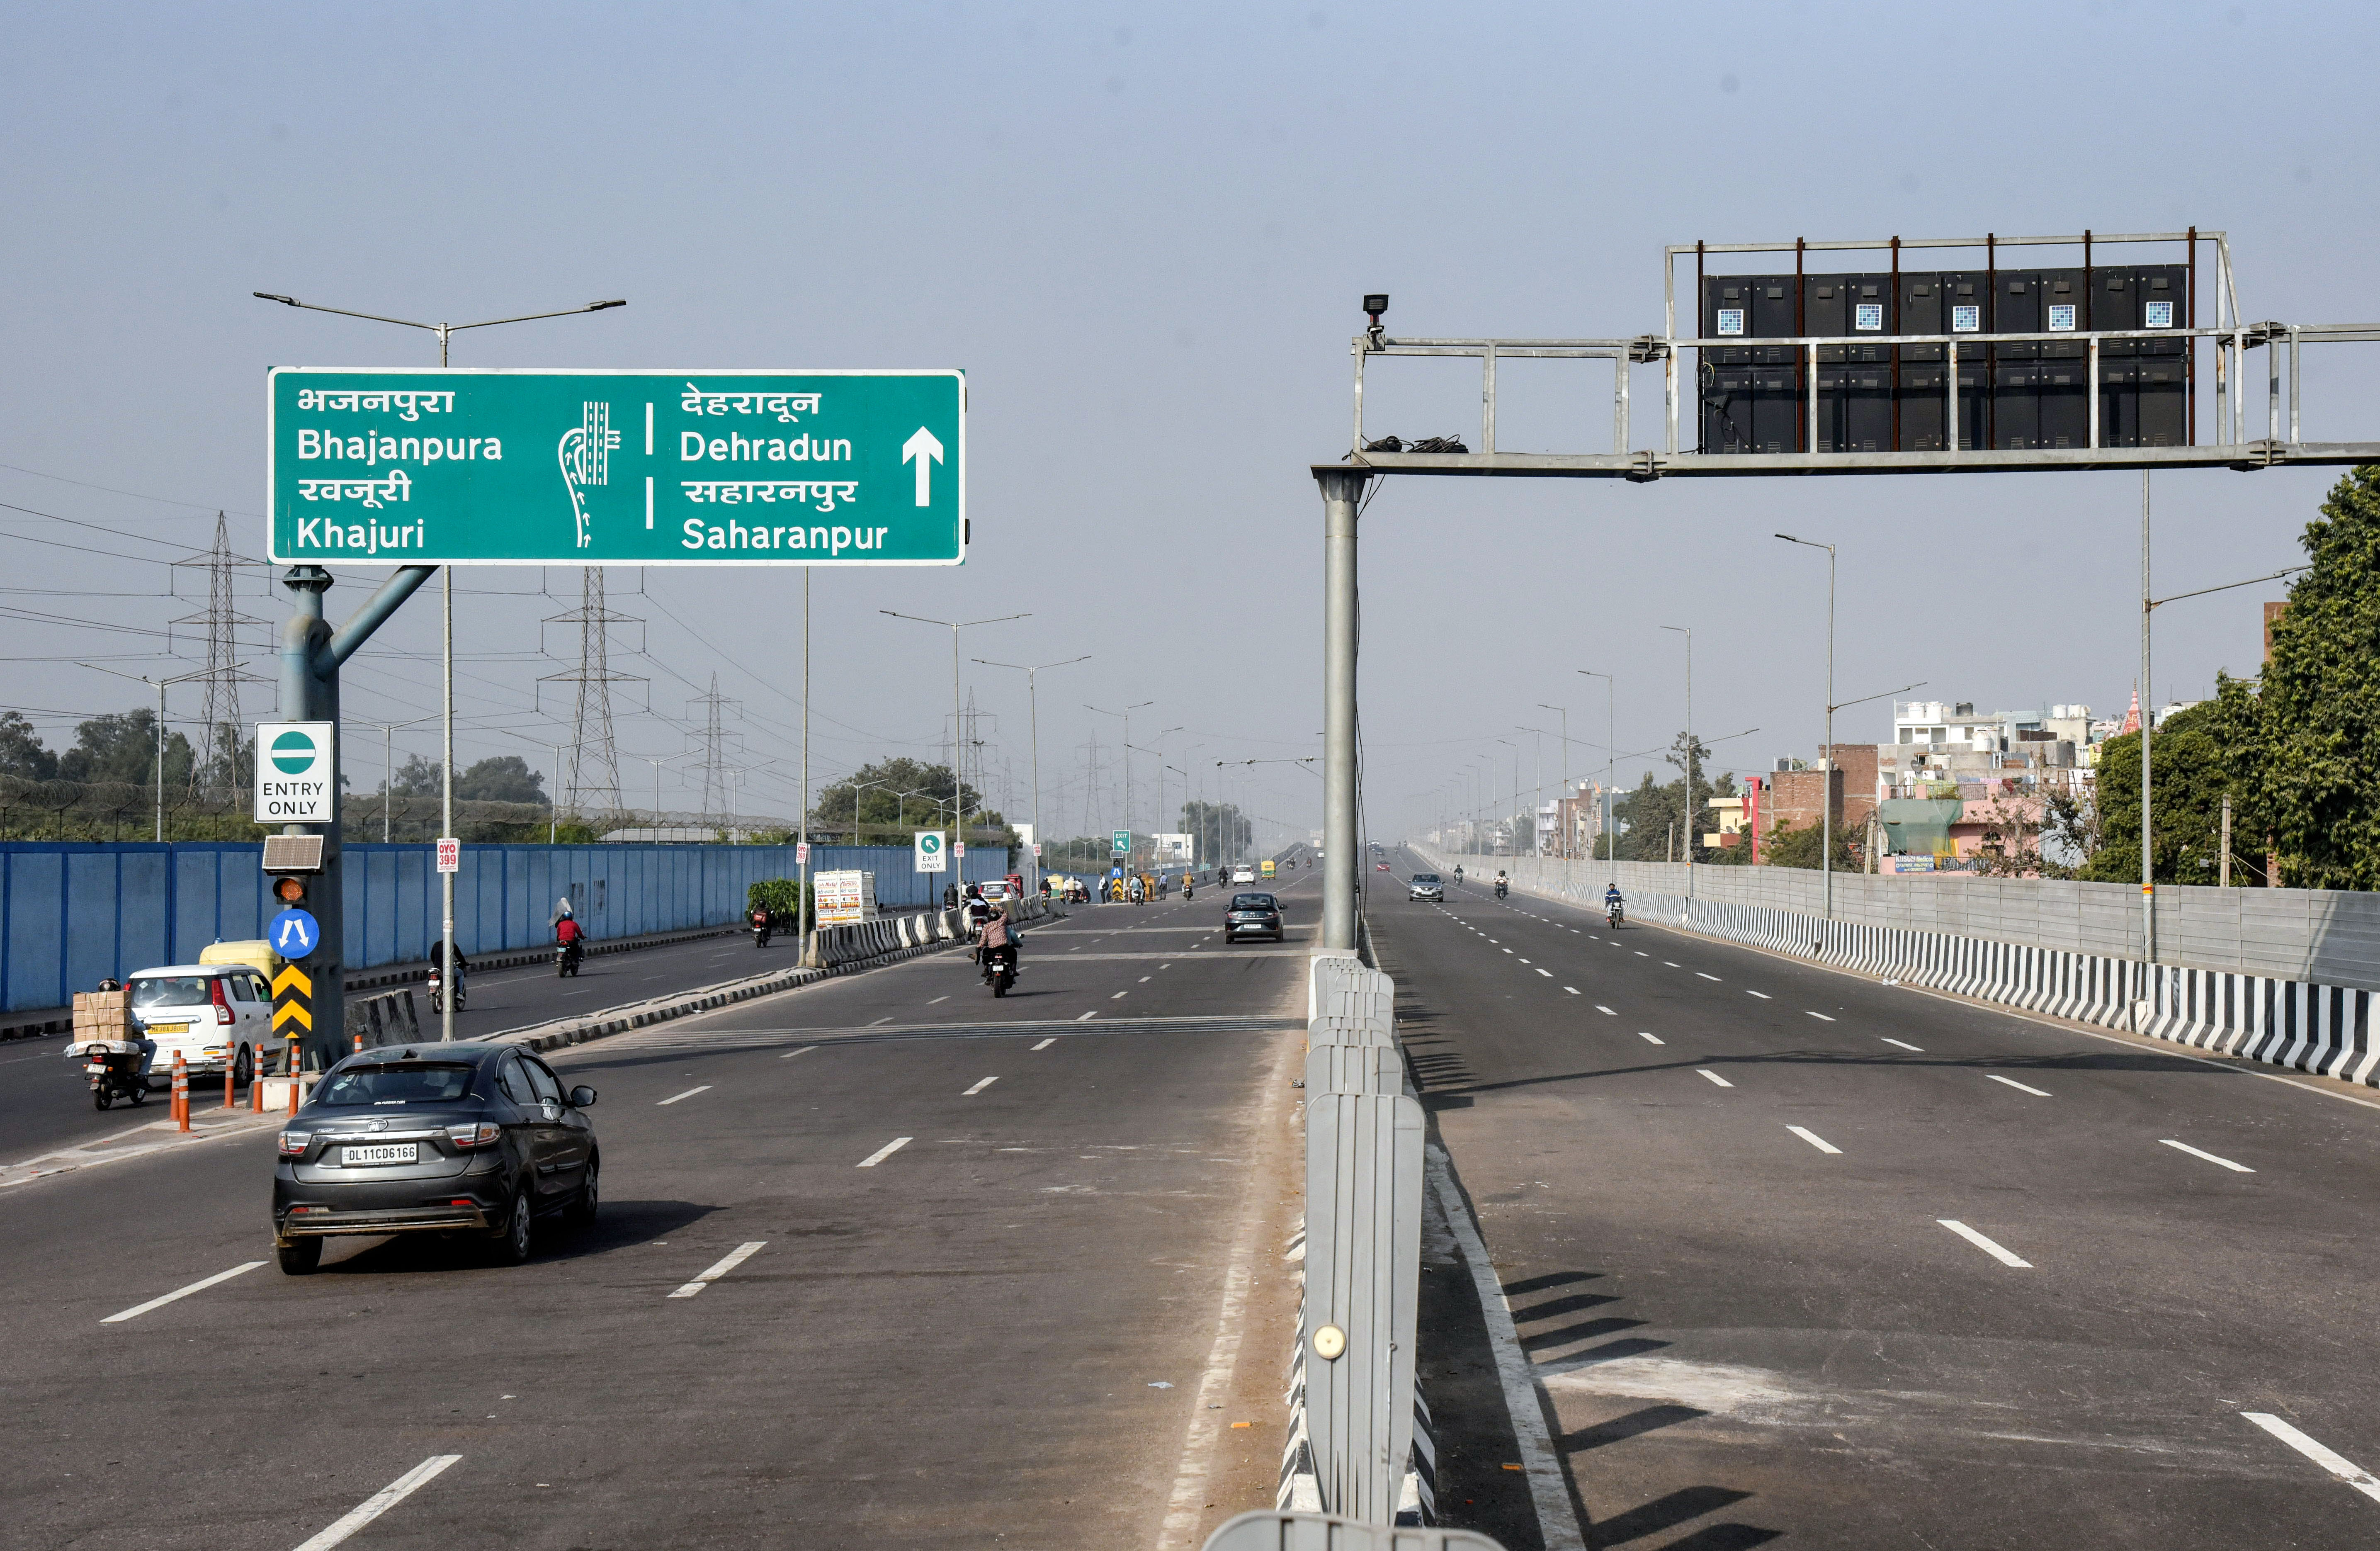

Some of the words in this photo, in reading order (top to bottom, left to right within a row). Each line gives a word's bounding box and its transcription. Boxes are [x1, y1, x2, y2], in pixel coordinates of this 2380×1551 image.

[299, 389, 455, 421] भजनपुरा
[681, 382, 822, 422] देहरादून
[299, 430, 502, 465] Bhajanpura
[681, 432, 851, 461] Dehradun
[681, 481, 858, 512] सहारनपुर
[298, 518, 423, 554] Khajuri
[681, 518, 888, 556] Saharanpur
[264, 783, 323, 795] ENTRY
[269, 801, 317, 814] ONLY
[439, 844, 456, 853] OYO
[439, 854, 456, 865] 399
[349, 1147, 415, 1161] DL11CD6166
